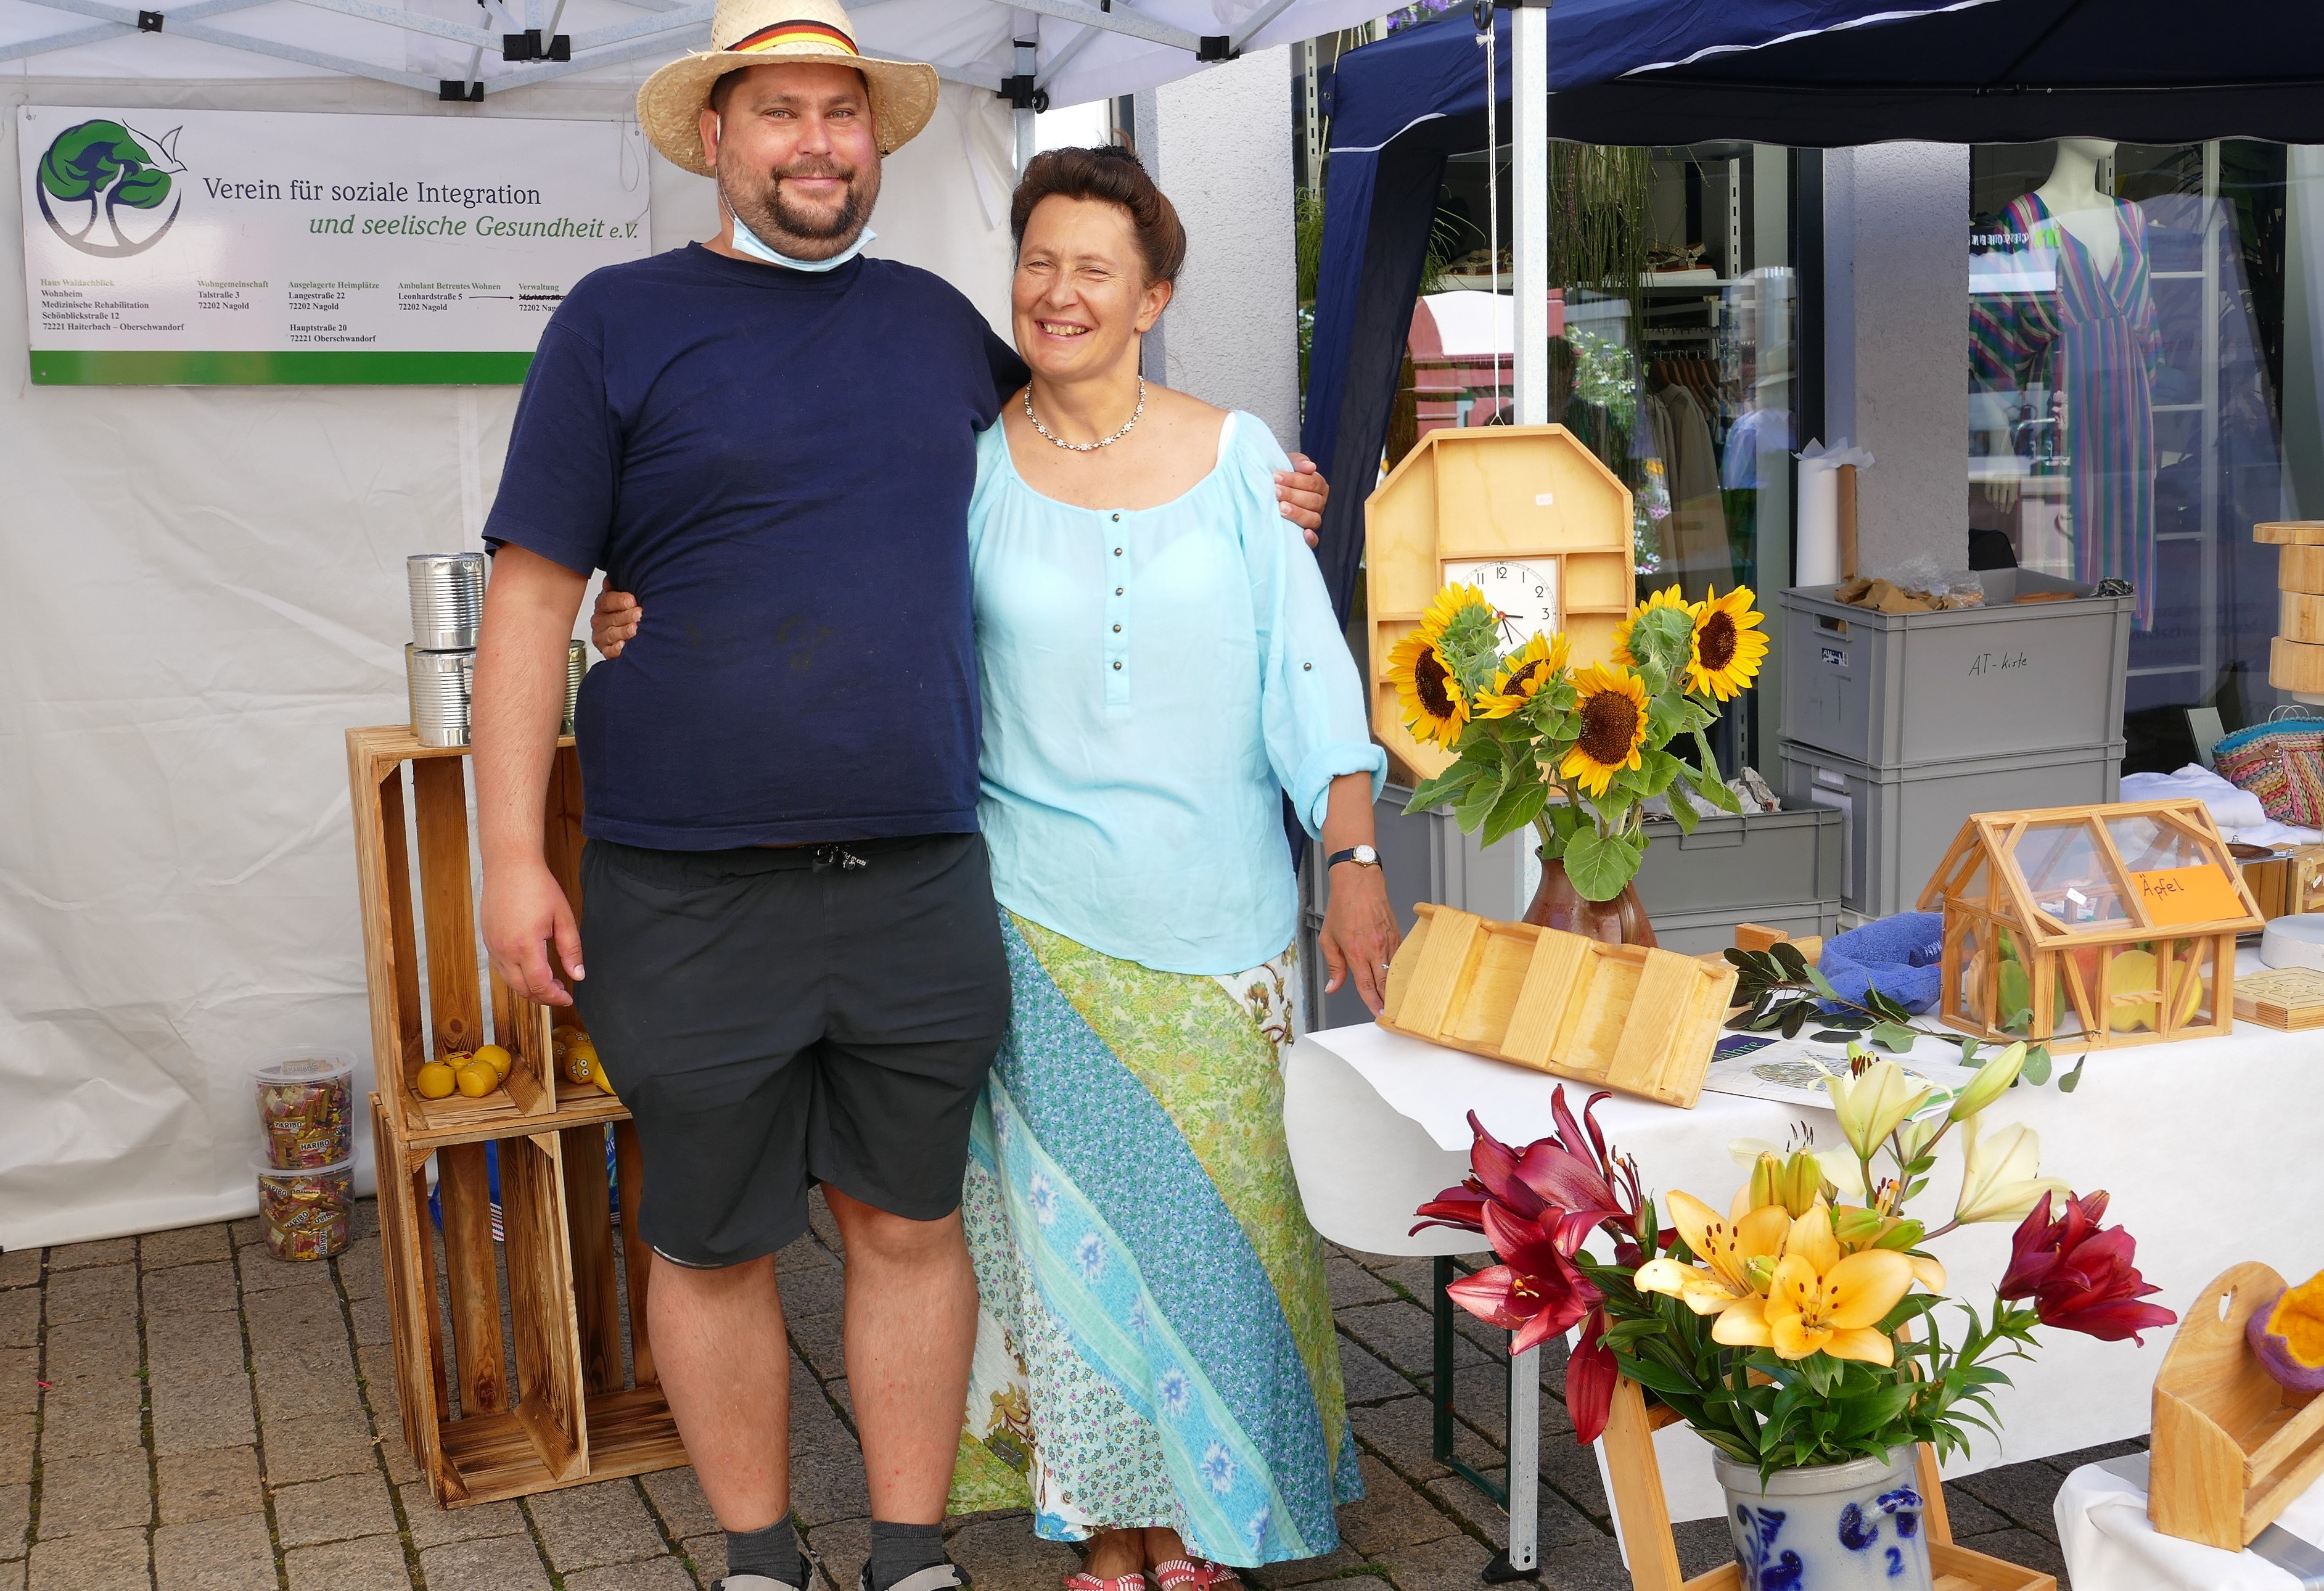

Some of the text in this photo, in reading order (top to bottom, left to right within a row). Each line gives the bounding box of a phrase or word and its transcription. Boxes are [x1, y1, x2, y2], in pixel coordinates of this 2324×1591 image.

[203, 178, 541, 208] Verein für soziale Integration
[310, 214, 638, 238] und seelische Gesundheit e.V.
[197, 281, 268, 289] Wohngemeinschaft
[289, 281, 379, 290] Ausgelagerte Heimplätze
[519, 284, 559, 292] Verwaltung
[289, 292, 334, 300] Langestraße
[223, 302, 248, 310] Nagold
[313, 303, 339, 311] Nagold
[542, 305, 556, 313] Nag
[290, 324, 336, 332] Hauptstraße
[1497, 567, 1507, 579] 12
[1535, 585, 1543, 598] 2
[1542, 607, 1550, 620] 3
[2139, 874, 2184, 901] Äpfel
[300, 1139, 330, 1151] HARIBO
[319, 1230, 327, 1256] HARIBO
